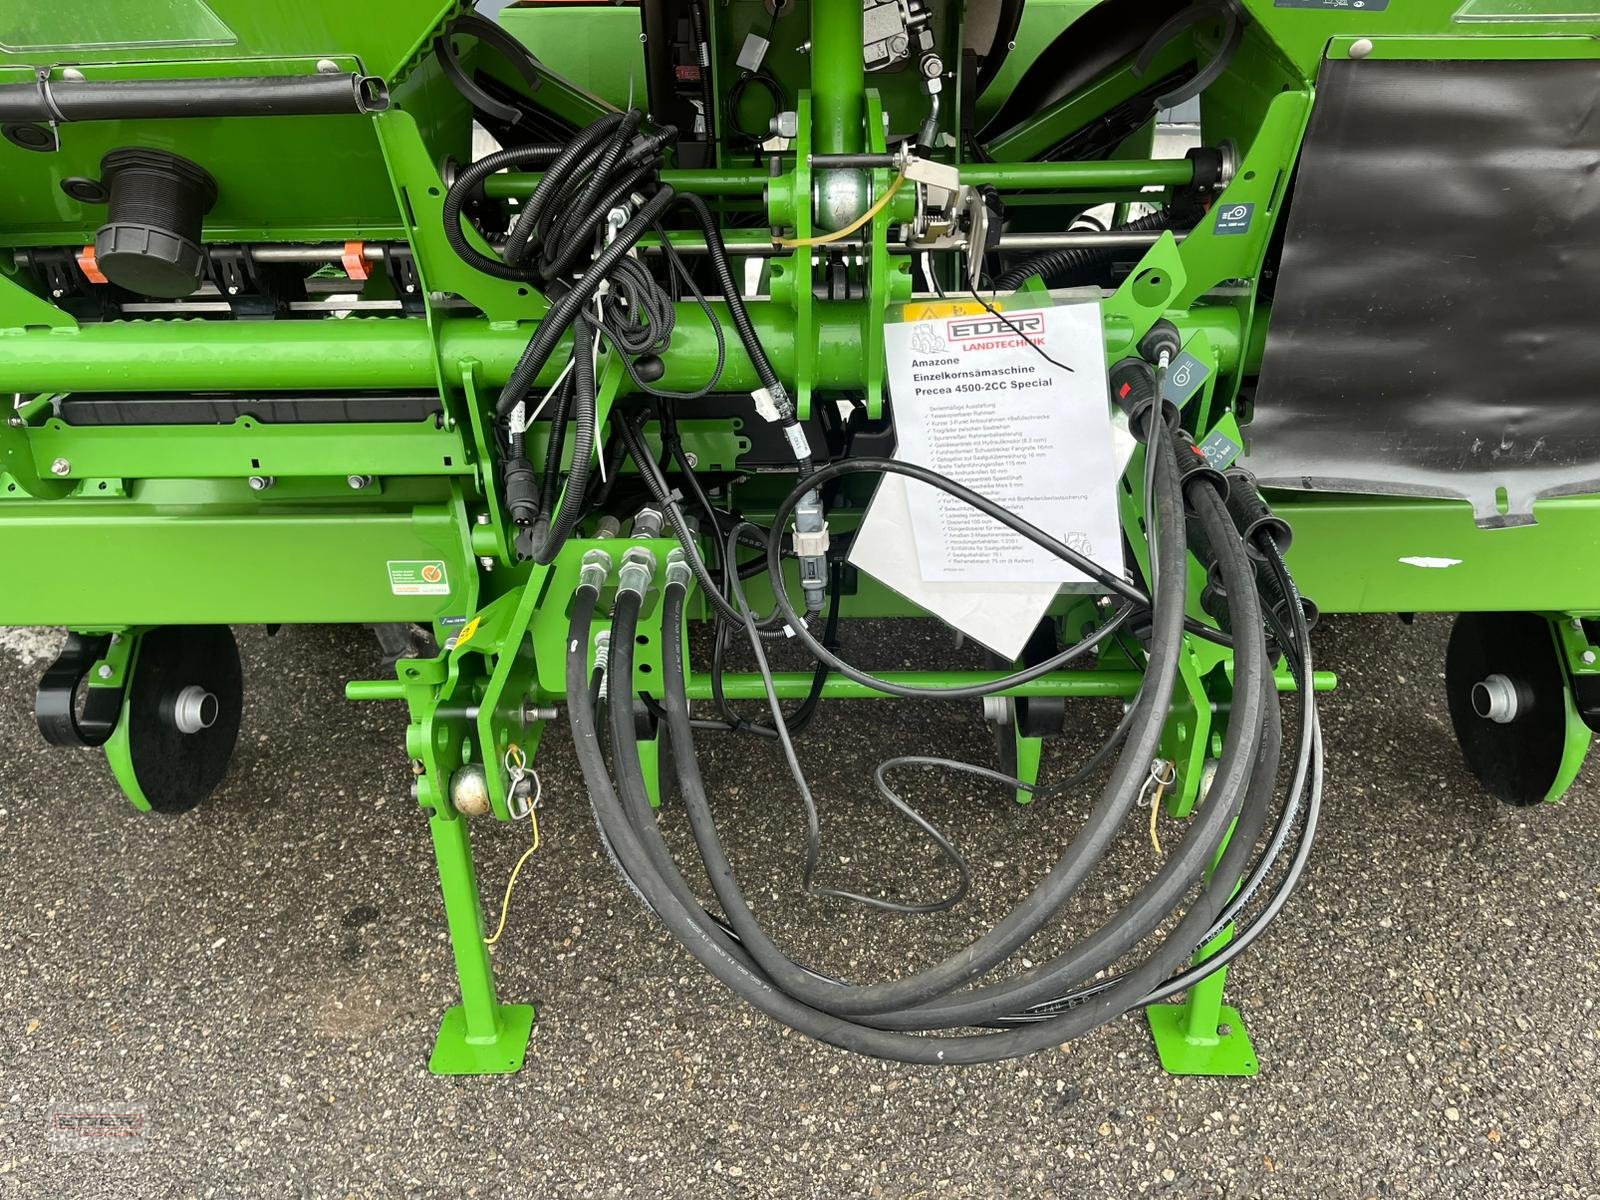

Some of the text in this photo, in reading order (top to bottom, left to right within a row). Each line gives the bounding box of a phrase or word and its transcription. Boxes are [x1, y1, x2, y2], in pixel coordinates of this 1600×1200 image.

[951, 317, 1041, 337] EDER
[962, 337, 1046, 352] LANDTECHNIK
[911, 356, 961, 368] Amazone
[913, 365, 1036, 382] Einzelkornsämaschine
[914, 377, 1053, 396] Precea 4500-2CC Special
